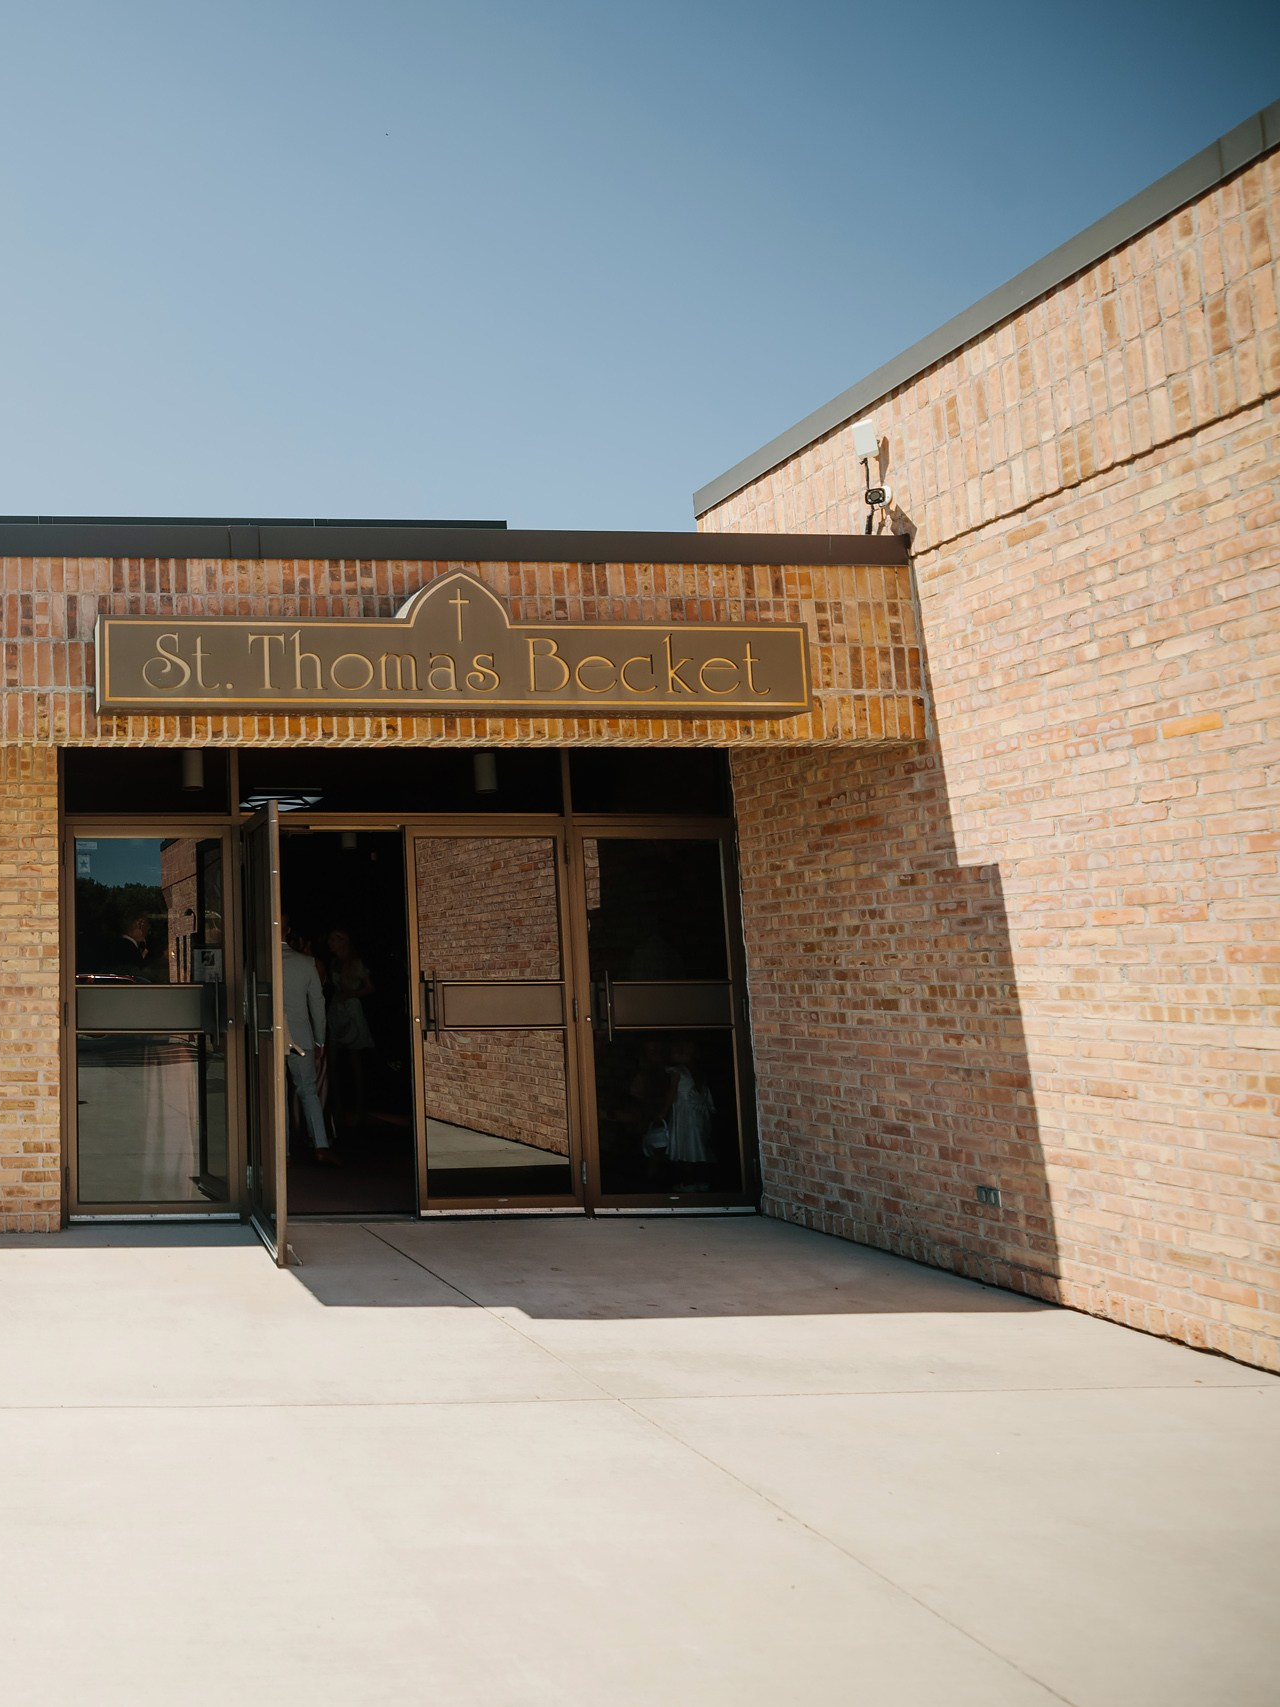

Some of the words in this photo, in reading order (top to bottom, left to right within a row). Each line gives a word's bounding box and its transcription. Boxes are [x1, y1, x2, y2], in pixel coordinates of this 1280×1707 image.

[142, 633, 233, 690] St.
[248, 629, 500, 692] Thomas
[526, 634, 770, 696] Becket
